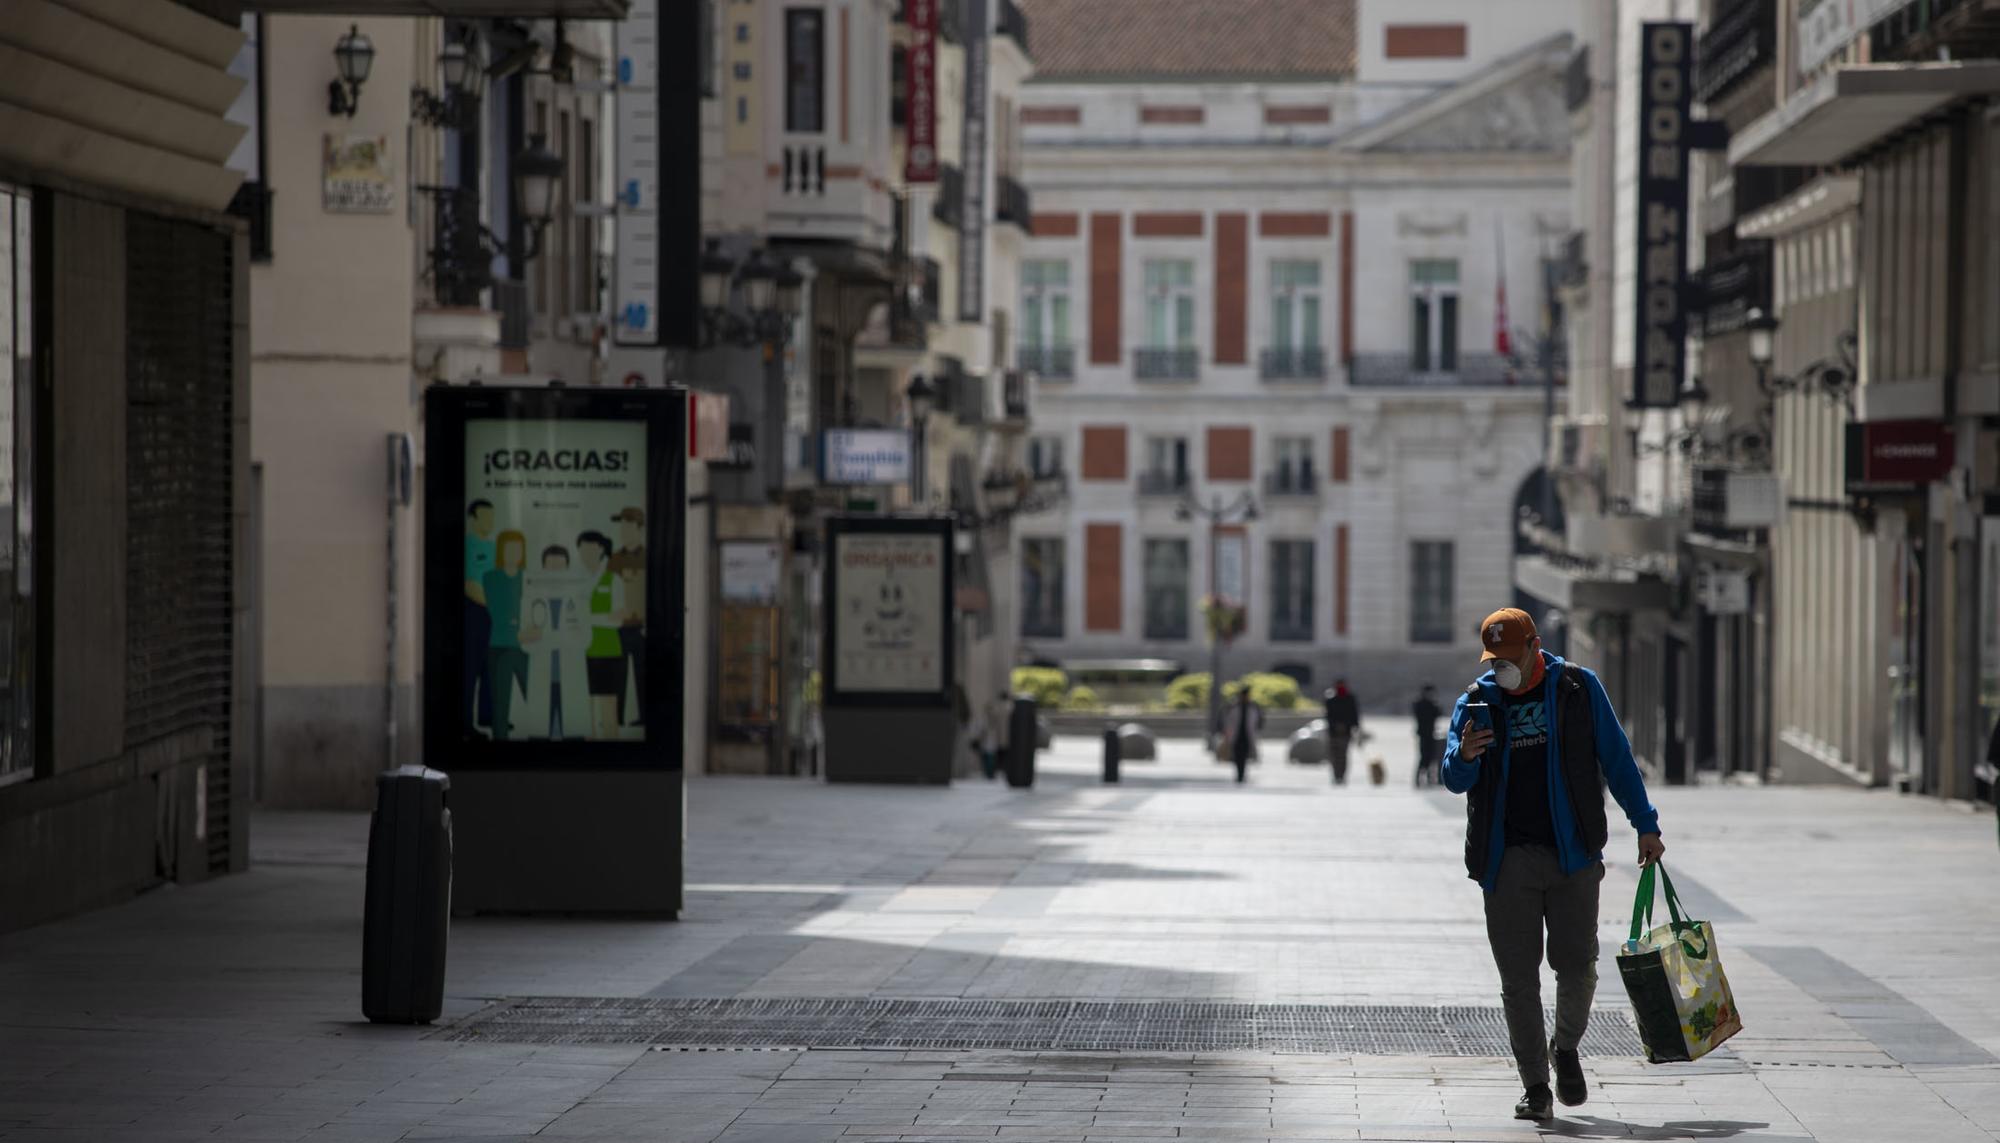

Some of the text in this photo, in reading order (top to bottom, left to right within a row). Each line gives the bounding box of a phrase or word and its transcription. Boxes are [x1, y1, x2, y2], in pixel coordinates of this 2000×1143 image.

[1646, 26, 1683, 405] SPORT 2000
[484, 448, 629, 475] ¡GRACIAS!
[1488, 623, 1504, 643] T
